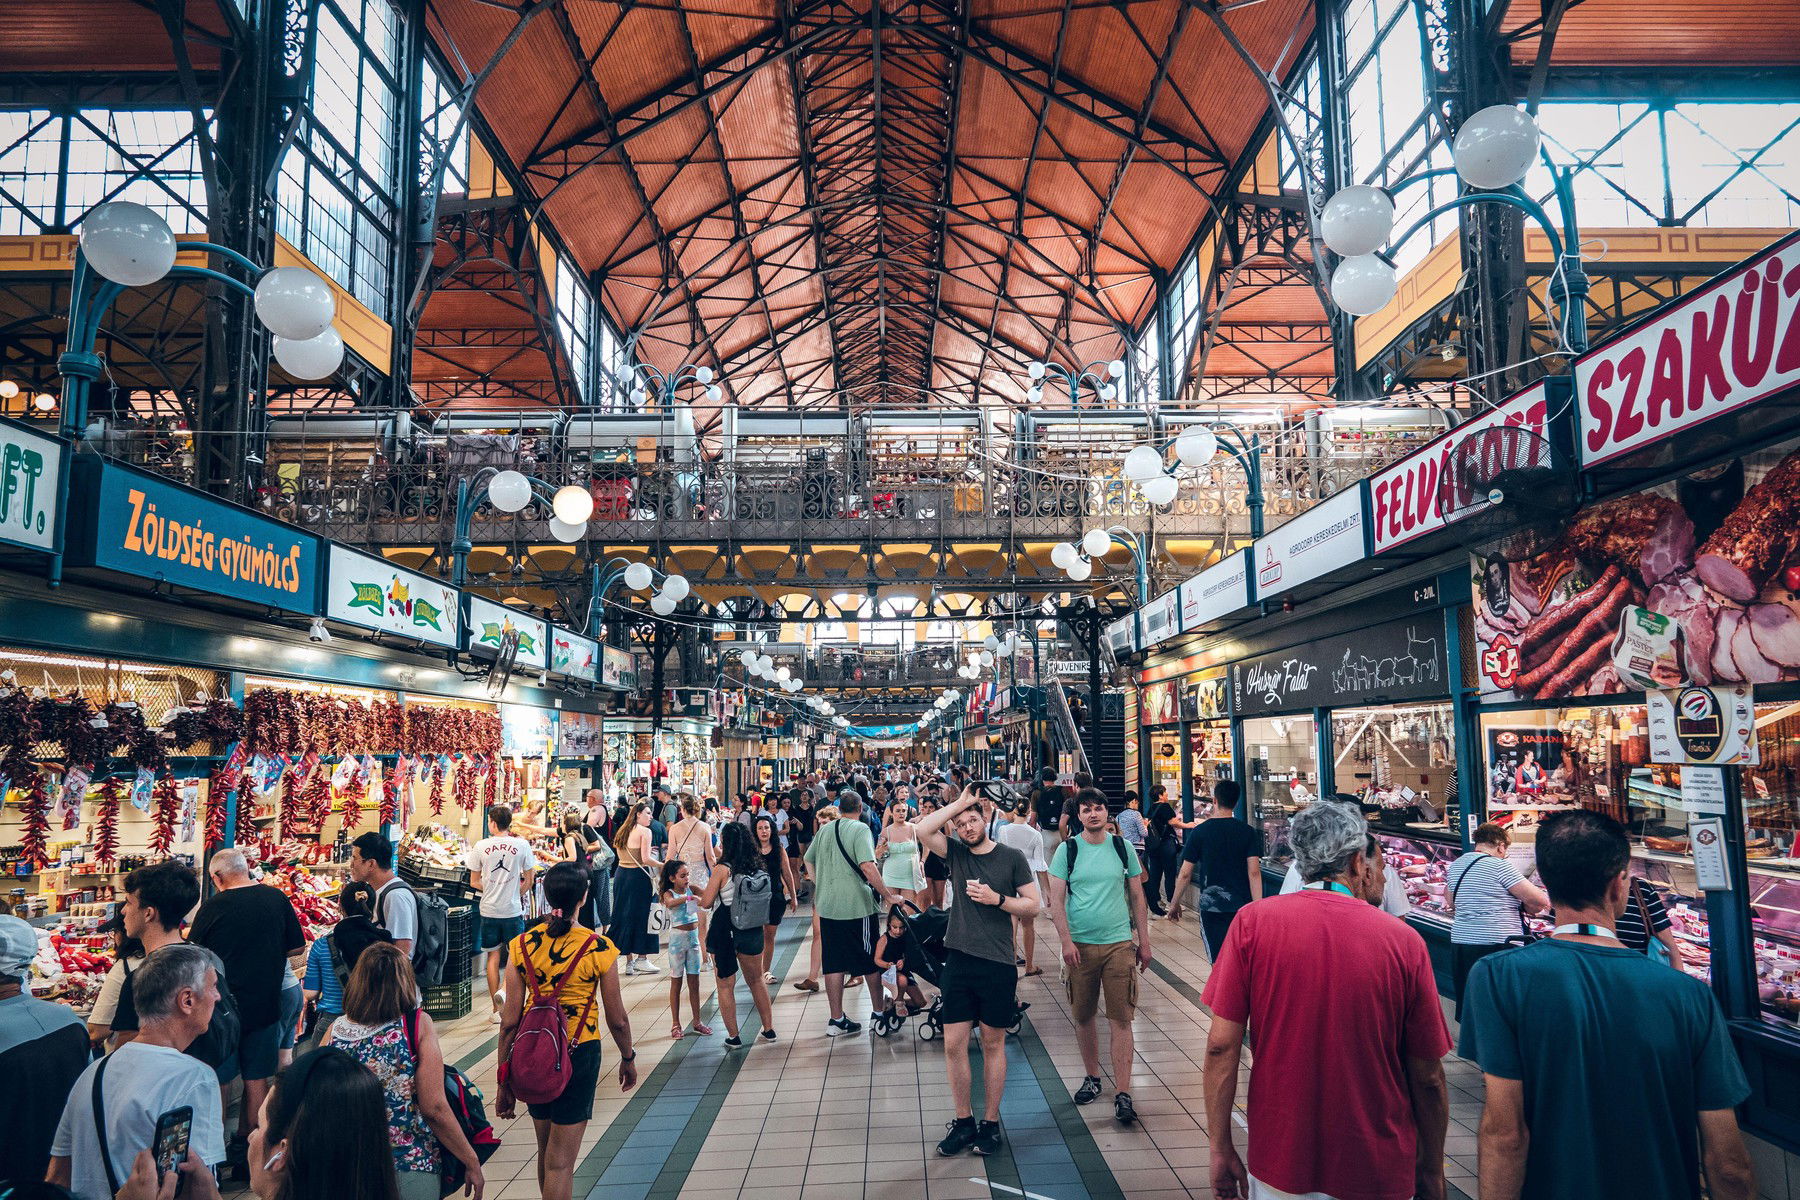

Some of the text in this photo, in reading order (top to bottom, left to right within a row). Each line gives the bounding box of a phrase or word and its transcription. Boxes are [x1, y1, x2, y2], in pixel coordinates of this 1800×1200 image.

[0, 442, 46, 535] FT.
[1289, 536, 1313, 555] AGROCORP
[1313, 518, 1350, 544] KERESKEDELMI
[1414, 590, 1419, 602] C
[1282, 658, 1318, 695] Falat
[484, 843, 519, 855] PARIS
